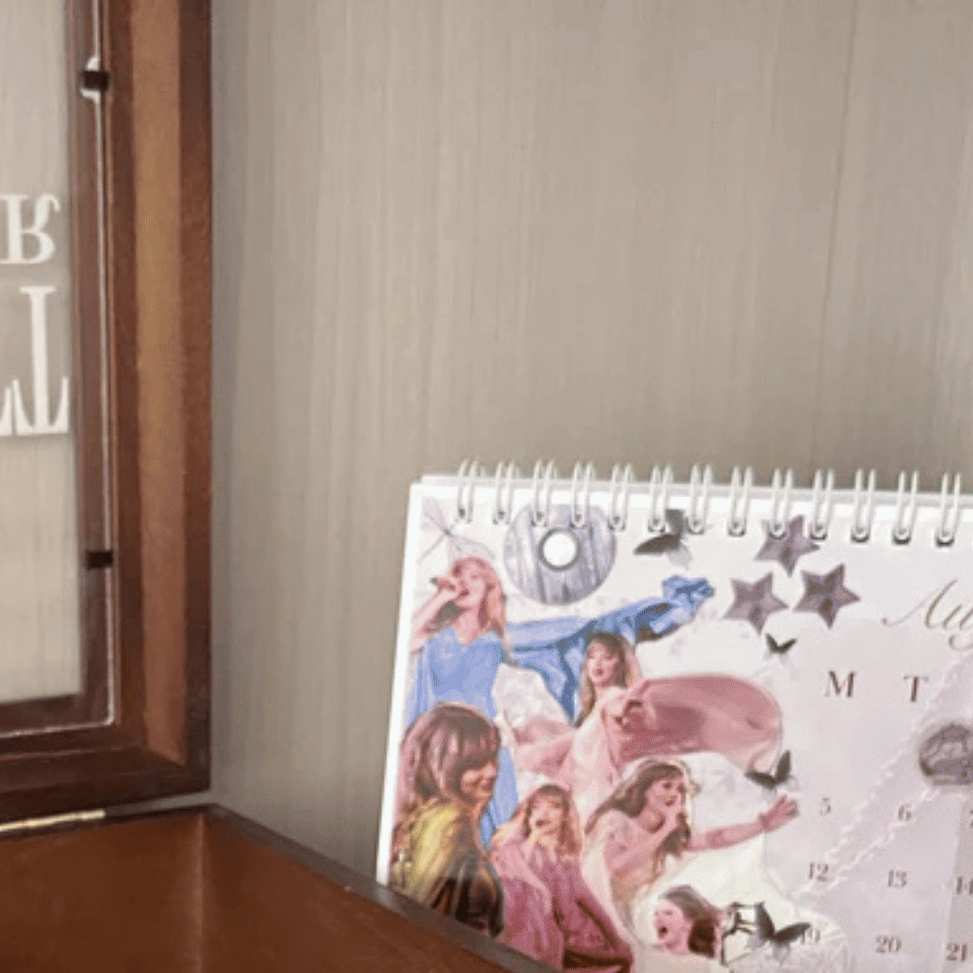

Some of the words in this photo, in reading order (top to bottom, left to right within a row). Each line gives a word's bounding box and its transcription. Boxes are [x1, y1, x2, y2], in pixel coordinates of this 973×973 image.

[880, 577, 973, 652] Au
[825, 670, 856, 699] M
[903, 673, 930, 703] T
[819, 797, 833, 816] 5
[898, 803, 912, 822] 6
[807, 861, 830, 882] 12
[887, 868, 908, 889] 13
[875, 934, 902, 954] 20
[945, 942, 968, 963] 21
